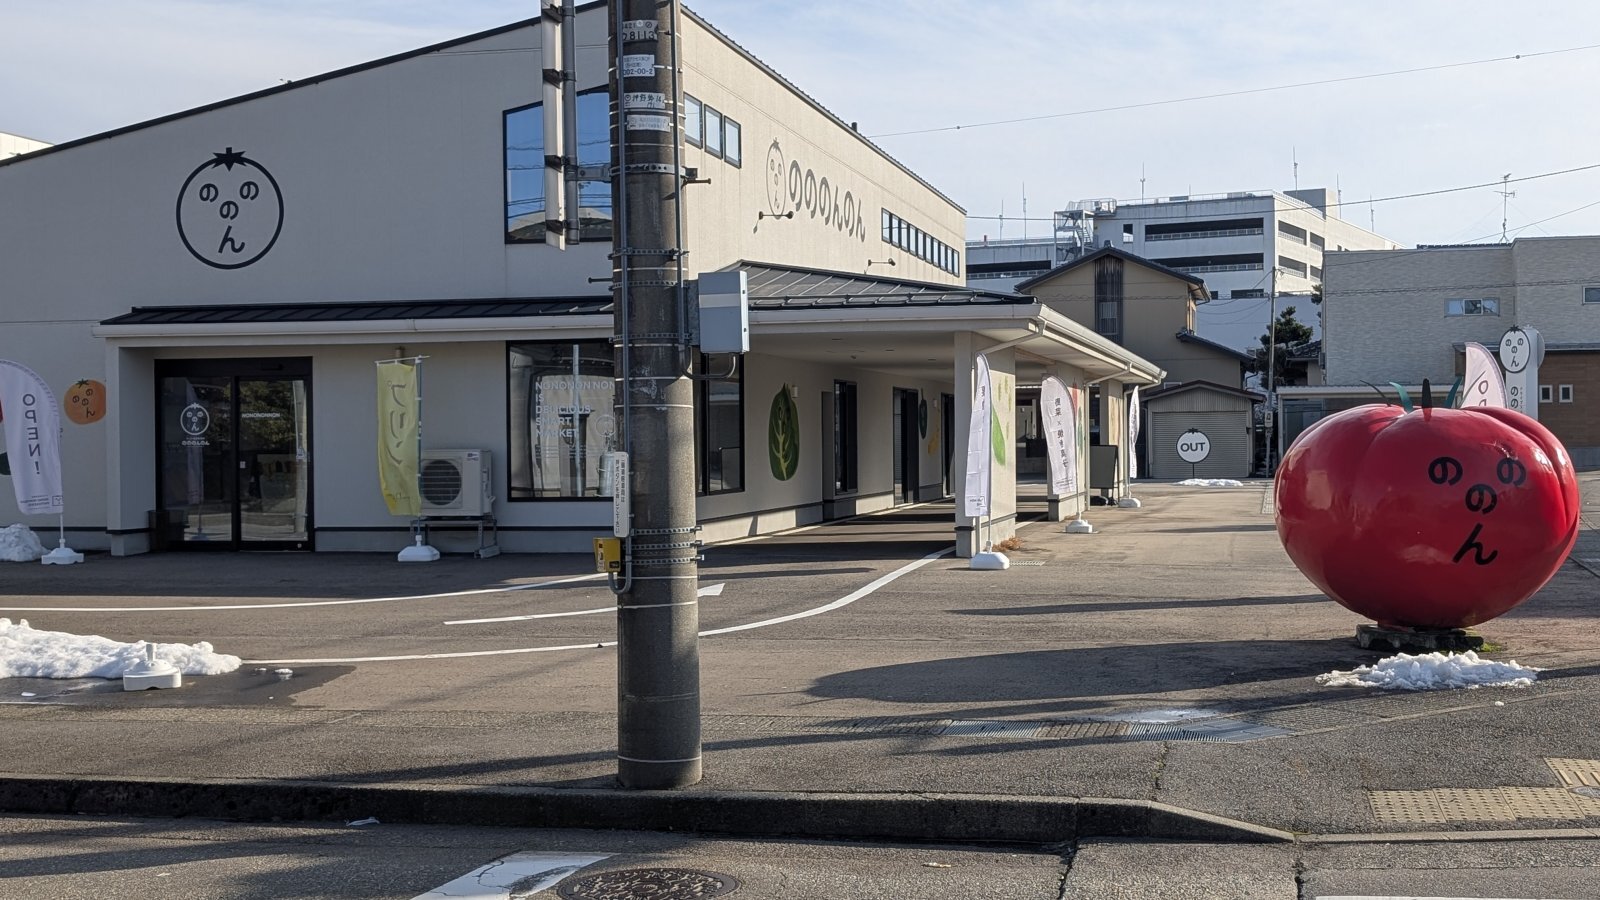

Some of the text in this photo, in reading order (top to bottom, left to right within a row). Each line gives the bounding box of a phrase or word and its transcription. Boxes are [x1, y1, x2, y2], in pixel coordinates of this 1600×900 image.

[789, 159, 866, 242] のののんのん
[535, 393, 545, 402] IS
[535, 405, 591, 414] DELICIOUS
[1180, 442, 1206, 452] OUT
